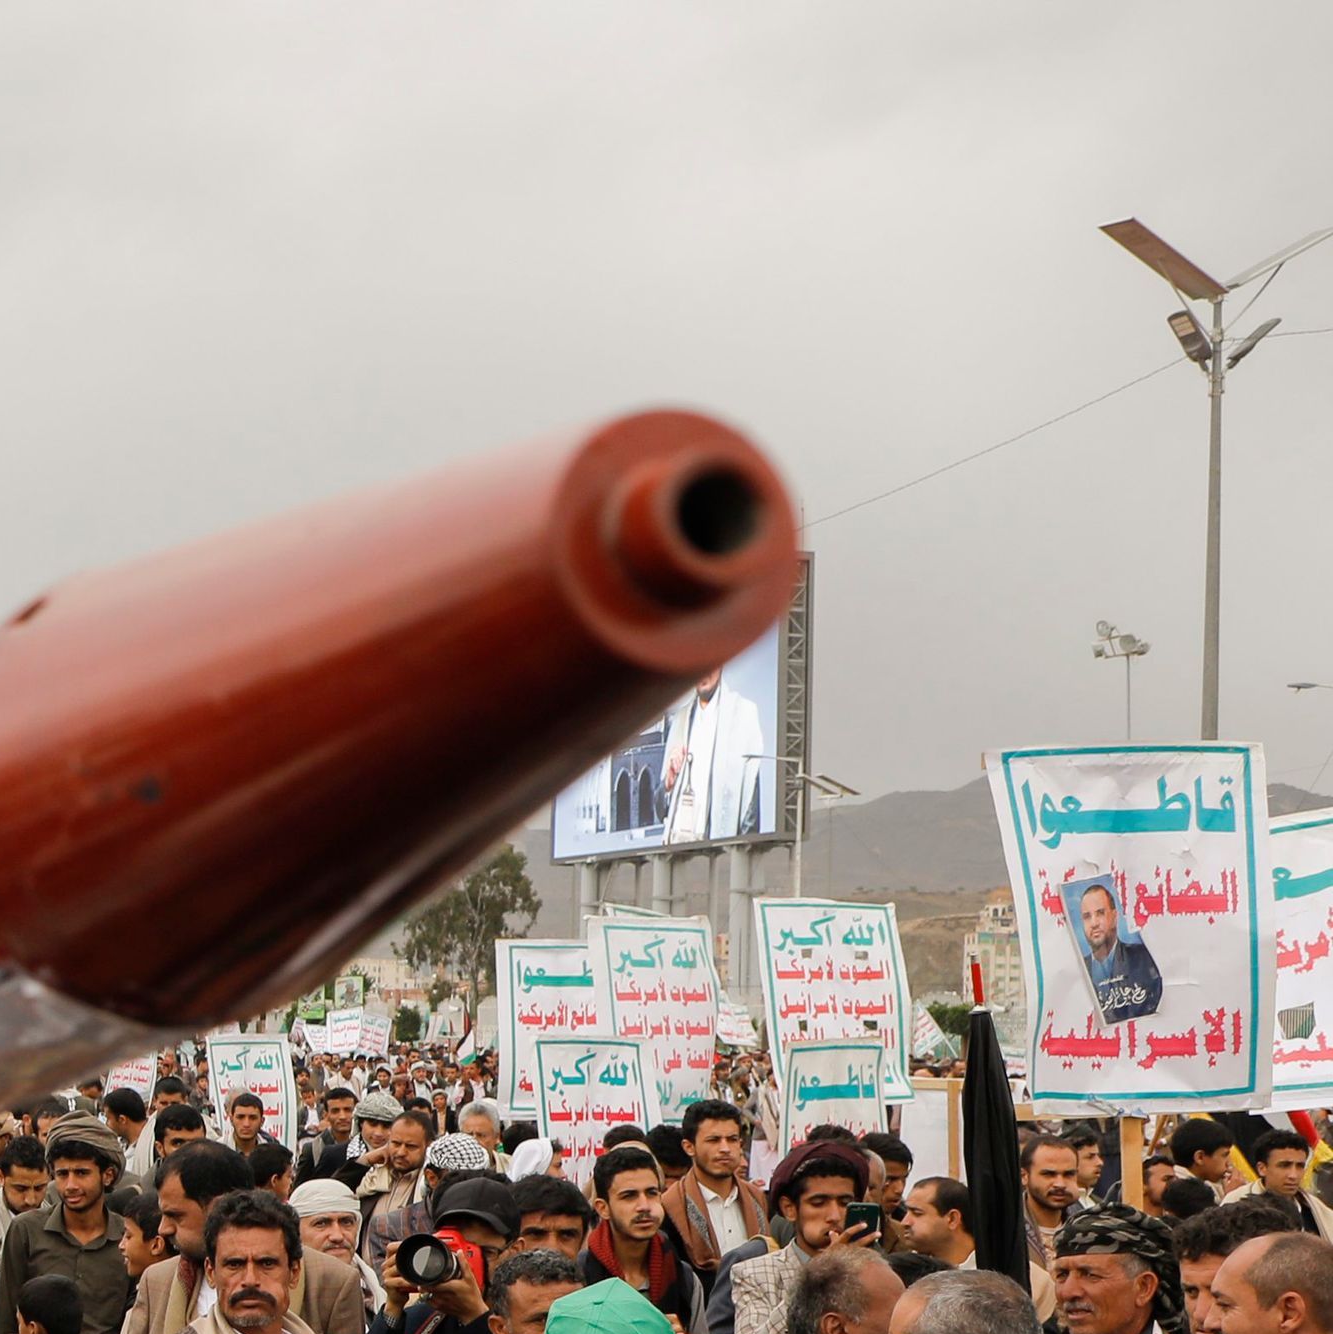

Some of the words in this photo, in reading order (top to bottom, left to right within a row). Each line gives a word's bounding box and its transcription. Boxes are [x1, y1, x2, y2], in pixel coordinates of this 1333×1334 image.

[1020, 774, 1237, 849] قاطعوا
[1132, 865, 1238, 928] البضائع
[773, 910, 836, 955] أكبر
[613, 934, 665, 977] أكبر
[774, 954, 834, 985] لأمريكا
[517, 960, 594, 993] طعوا
[839, 959, 890, 985] الموت
[614, 977, 667, 1006] لأمريكا
[670, 982, 712, 1007] الموت
[842, 993, 894, 1019] الموت
[517, 1000, 568, 1031] الأمريكية
[674, 1016, 715, 1040] الموت
[218, 1046, 251, 1078] أكبر
[547, 1048, 597, 1096] أكبر
[793, 1064, 876, 1112] قاطعوا
[592, 1100, 641, 1126] الموت
